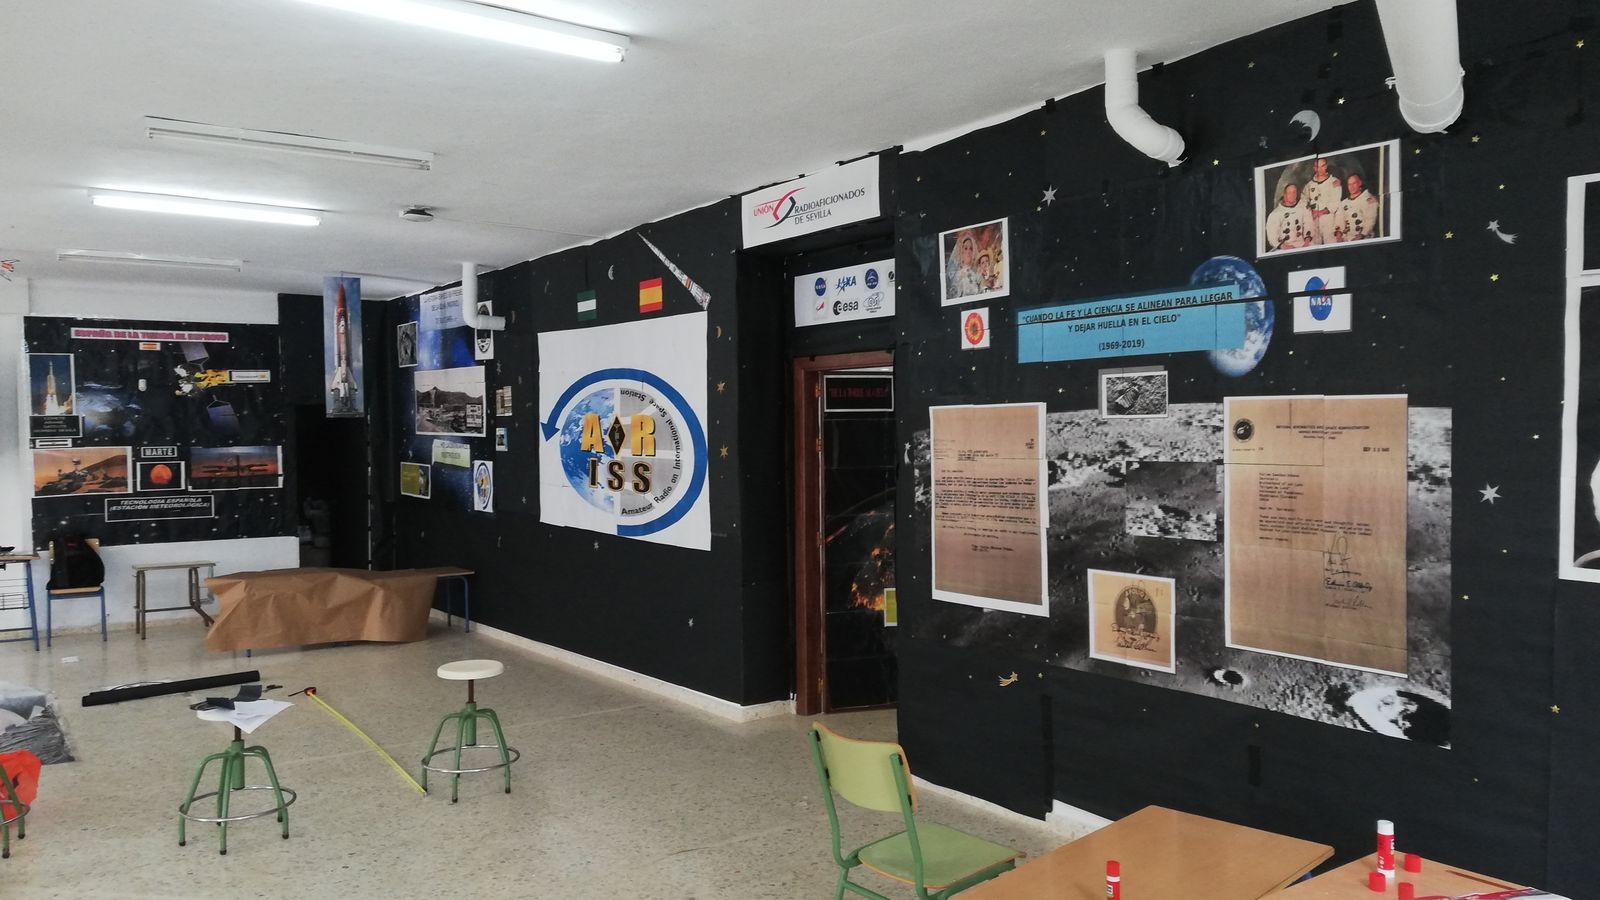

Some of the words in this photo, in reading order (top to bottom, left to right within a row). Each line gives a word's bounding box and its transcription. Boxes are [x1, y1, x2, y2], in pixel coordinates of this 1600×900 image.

[794, 187, 866, 214] RADIOAFICIONADOS
[794, 216, 803, 225] DE
[806, 209, 832, 222] SEVILLA
[1023, 312, 1054, 324] "CUANDO
[1055, 311, 1064, 320] LA
[1066, 310, 1076, 318] FE
[1076, 309, 1082, 318] Y
[1083, 307, 1092, 317] LA
[1094, 304, 1122, 315] CIENCIA
[1125, 302, 1136, 312] SE
[1137, 298, 1173, 311] ALINEAN
[1175, 295, 1198, 306] PARA
[1200, 291, 1233, 304] LLEGAR
[1067, 325, 1073, 333] Y
[1074, 323, 1096, 334] DEJAR
[1097, 318, 1127, 330] HUELLA
[1128, 318, 1139, 327] EN
[1141, 316, 1152, 326] EL
[1098, 338, 1145, 352] (1969-2019)
[620, 389, 647, 402] Station
[648, 398, 667, 418] Space
[145, 448, 174, 456] MARTE
[665, 418, 681, 470] International
[588, 457, 652, 494] ISS
[671, 473, 679, 484] on
[653, 486, 673, 504] Radio
[621, 502, 653, 515] Amateur
